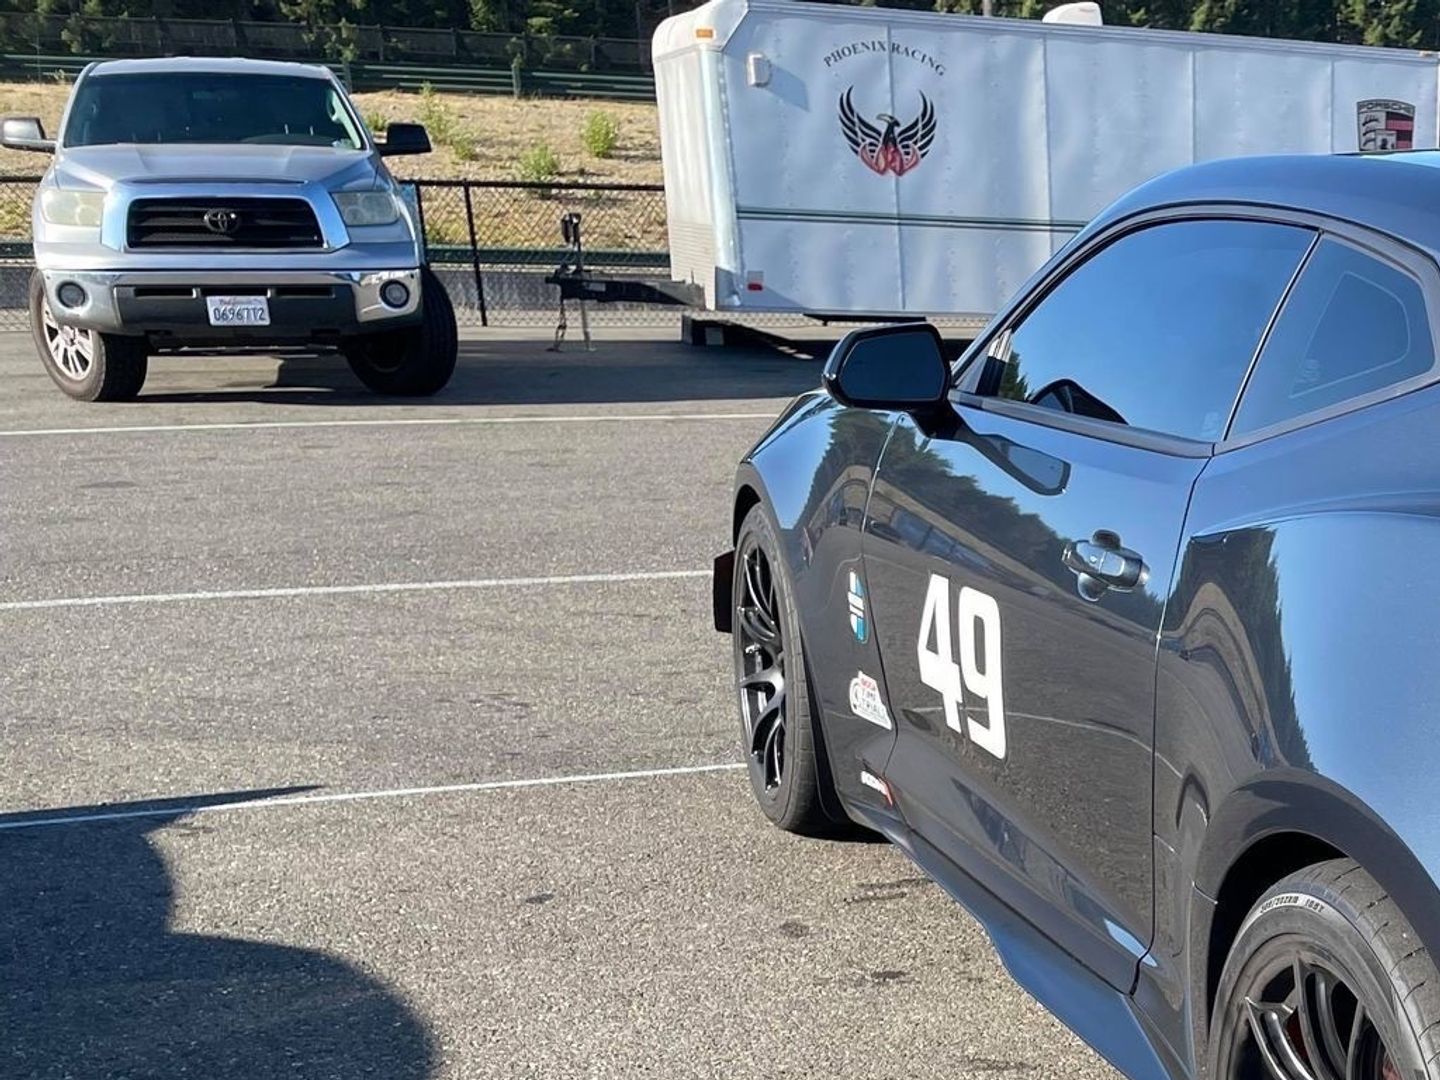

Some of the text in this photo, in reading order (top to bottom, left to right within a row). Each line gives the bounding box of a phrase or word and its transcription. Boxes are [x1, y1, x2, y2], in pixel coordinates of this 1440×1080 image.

[823, 40, 946, 76] PHOENIX RACING
[918, 574, 1005, 758] 49
